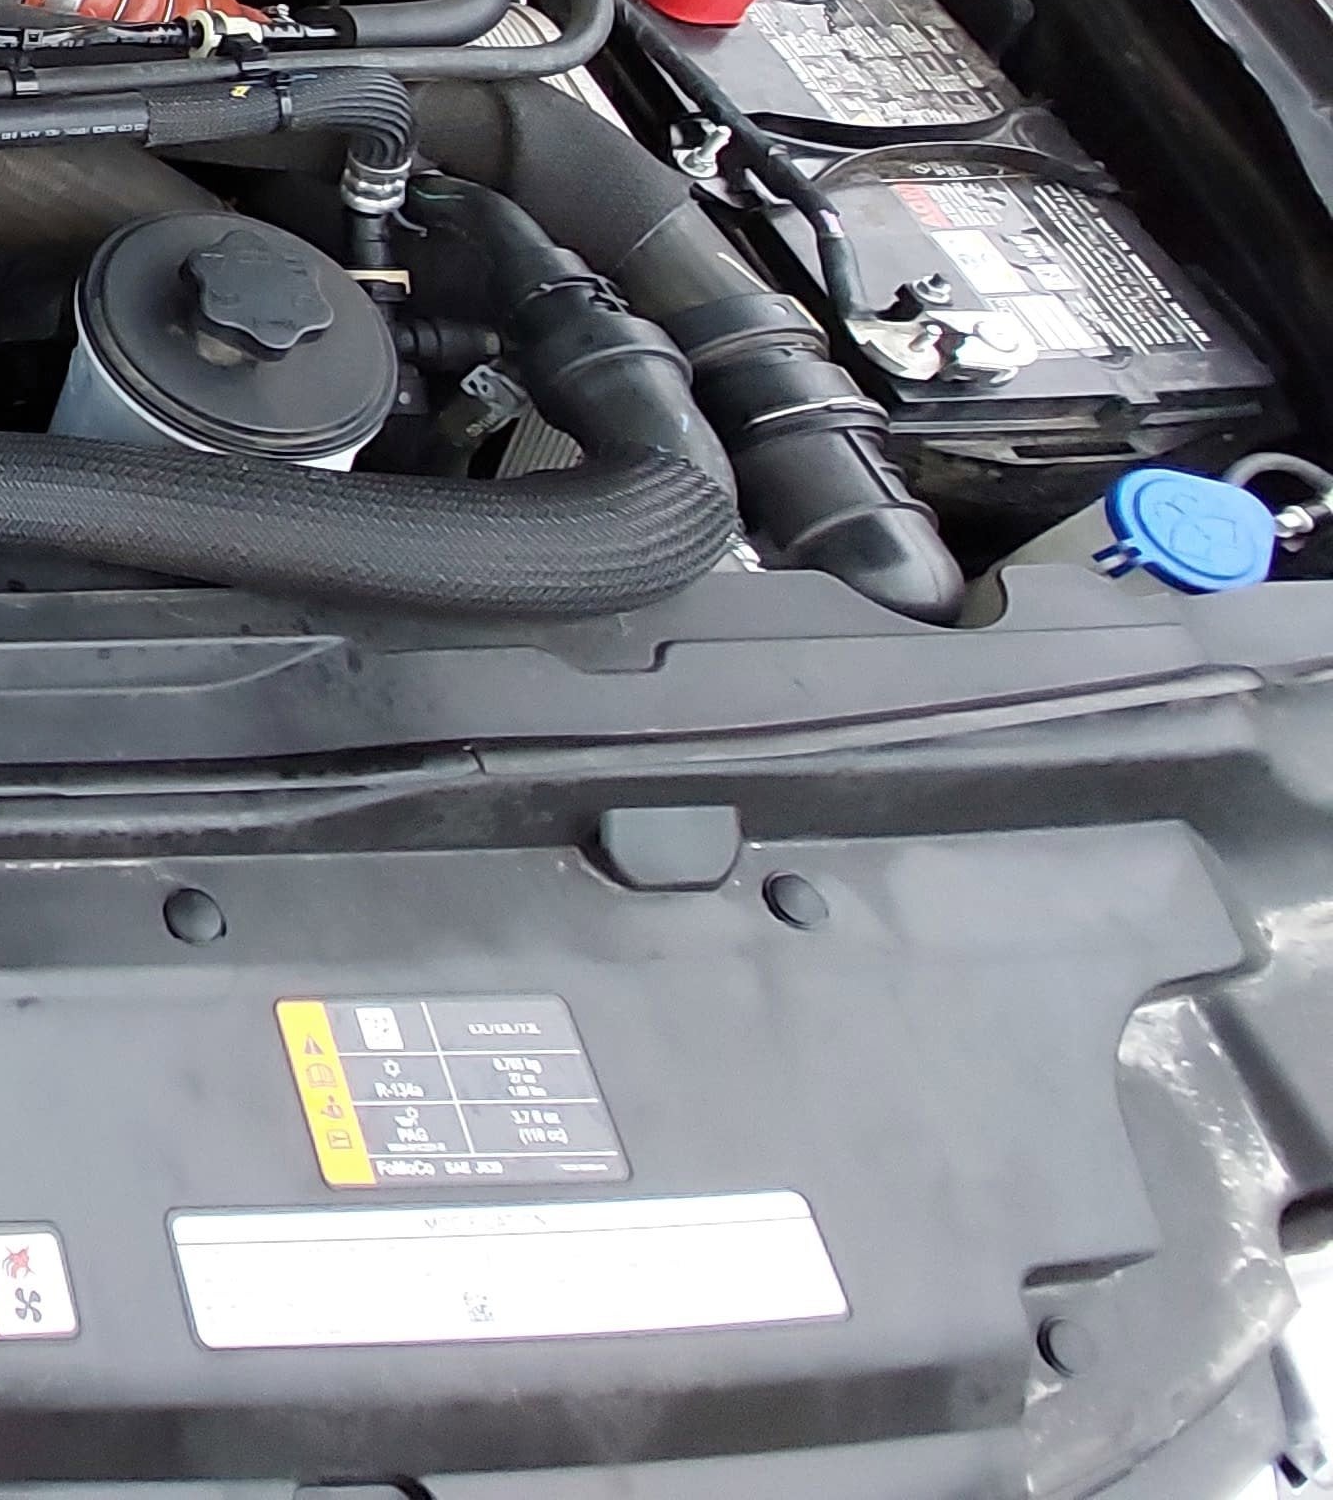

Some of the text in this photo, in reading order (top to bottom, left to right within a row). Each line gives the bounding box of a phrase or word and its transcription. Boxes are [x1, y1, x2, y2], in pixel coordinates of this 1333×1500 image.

[374, 1082, 425, 1098] R-134a
[396, 1128, 429, 1142] PAG
[376, 1160, 436, 1176] FoMoCo
